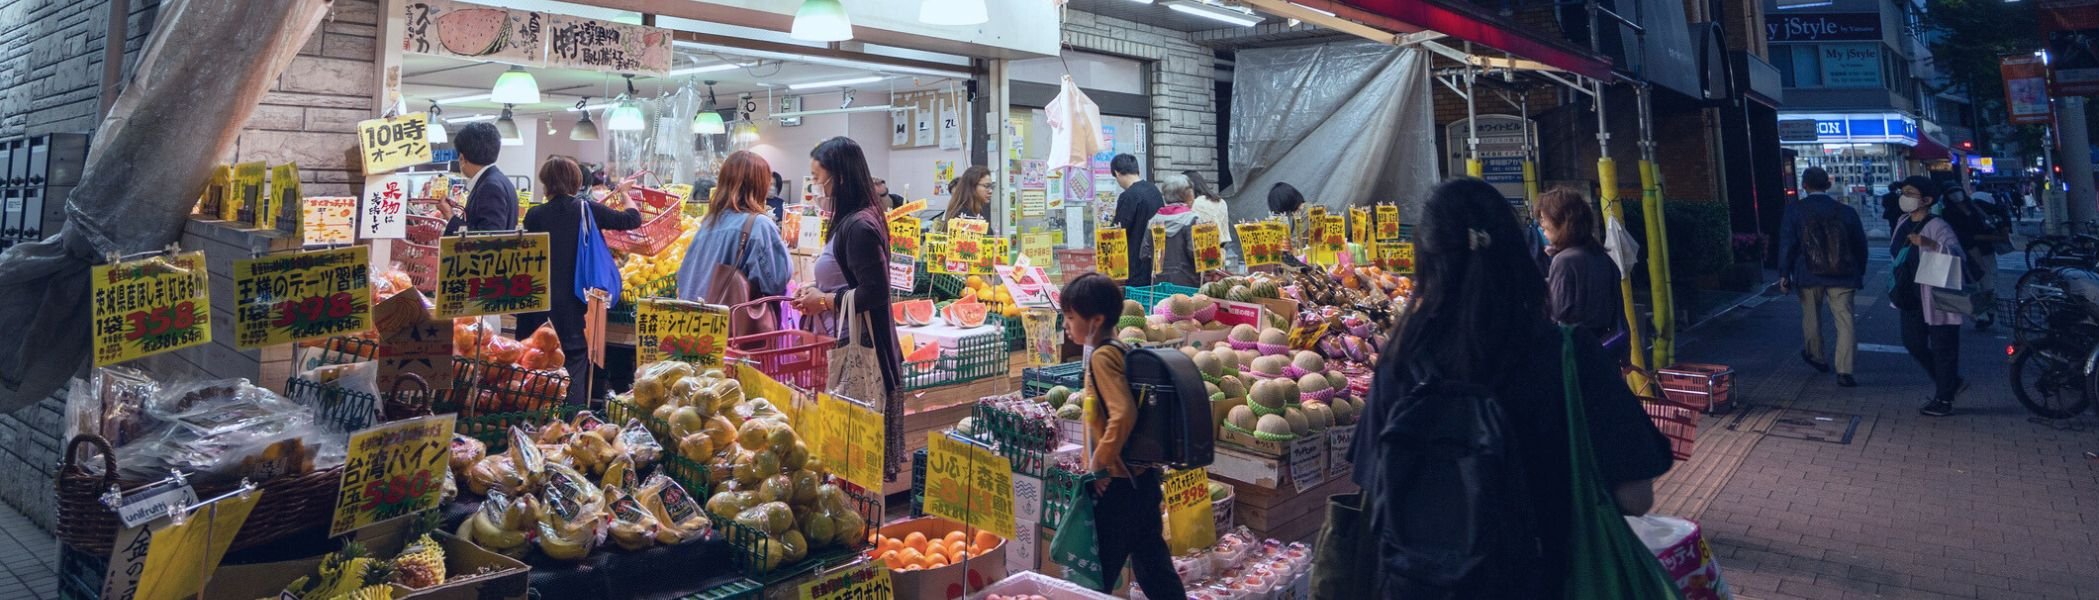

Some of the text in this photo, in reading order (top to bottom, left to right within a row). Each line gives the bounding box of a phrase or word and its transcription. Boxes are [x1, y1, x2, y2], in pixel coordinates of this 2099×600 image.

[414, 3, 431, 53] スイカ
[1784, 17, 1838, 39] jStyle
[365, 118, 425, 149] 10時
[371, 142, 426, 162] オープン
[380, 182, 402, 223] 果物は
[238, 264, 368, 305] 王様のデーツ習慣
[441, 279, 466, 294] 1袋
[96, 315, 124, 337] 1袋
[344, 440, 447, 488] 台湾パイン
[125, 501, 167, 523] unifrutti
